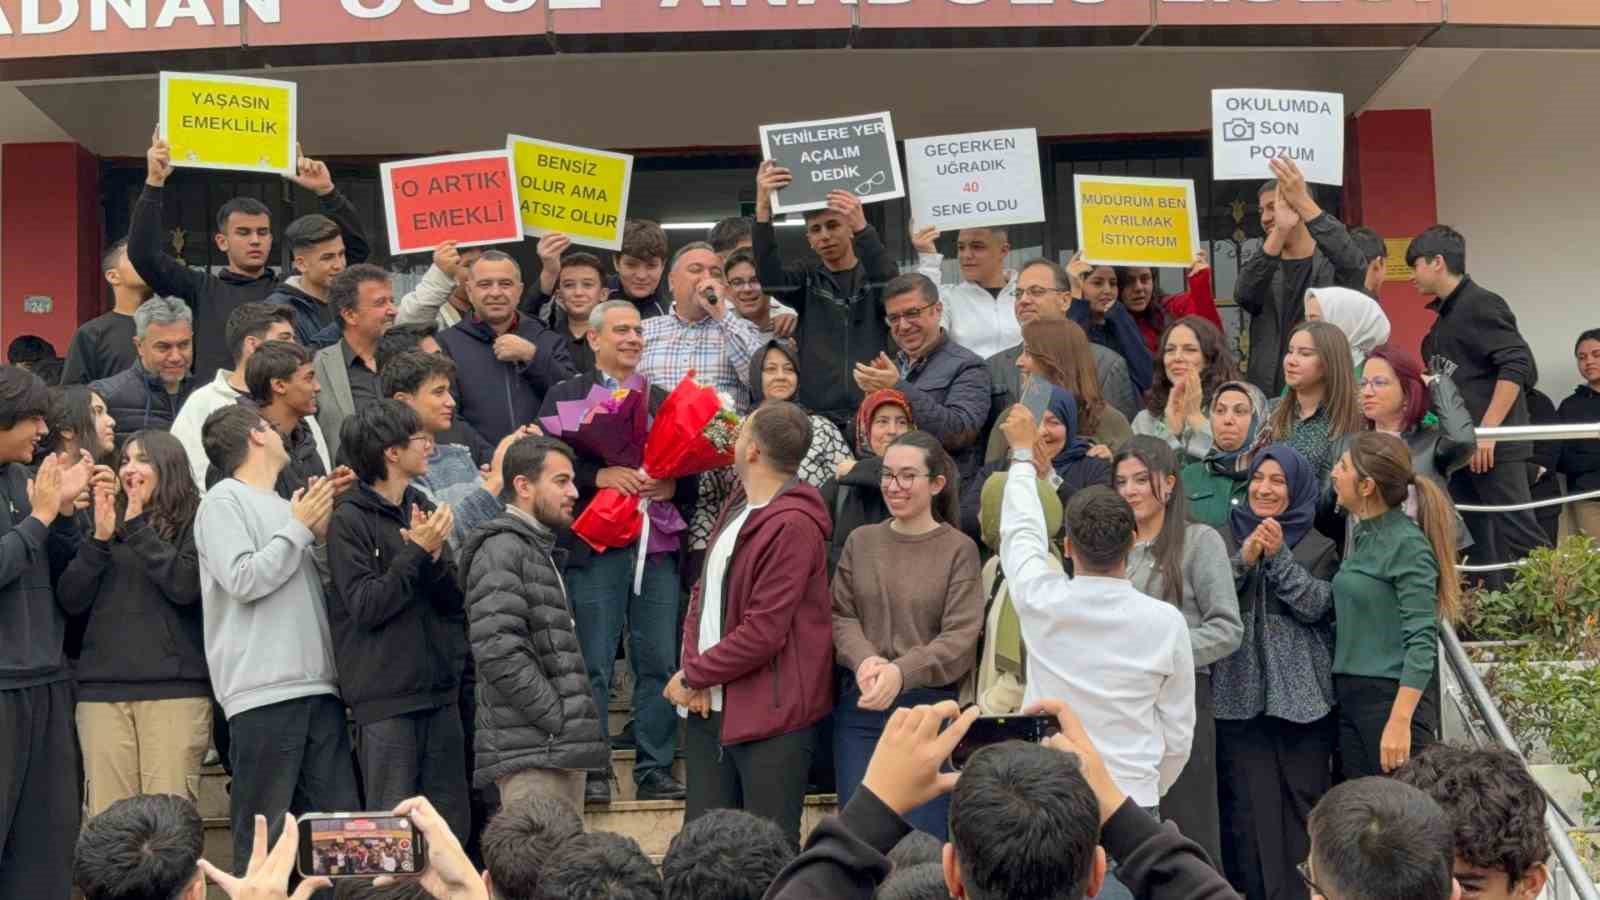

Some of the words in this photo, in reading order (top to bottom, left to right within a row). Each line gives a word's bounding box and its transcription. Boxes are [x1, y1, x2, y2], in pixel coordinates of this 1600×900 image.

[191, 91, 270, 111] YAŞASIN
[1225, 97, 1331, 115] OKULUMDA
[181, 115, 278, 135] EMEKLİLİK
[771, 127, 850, 146] YENİLERE
[852, 121, 885, 137] YER
[1259, 121, 1299, 135] SON
[800, 145, 861, 165] AÇALIM
[924, 137, 1016, 158] GEÇERKEN
[1249, 145, 1315, 162] POZUM
[537, 153, 598, 176] BENSİZ
[810, 164, 861, 182] DEDİK
[936, 159, 1006, 176] UĞRADIK
[520, 175, 566, 196] OLUR
[570, 184, 609, 202] AMA
[962, 181, 980, 193] 40
[931, 202, 973, 217] SENE
[975, 199, 1018, 213] OLDU
[1157, 197, 1187, 209] BEN
[412, 199, 505, 231] EMEKLİ
[570, 208, 618, 229] OLUR
[1102, 213, 1174, 229] AYRILMAK
